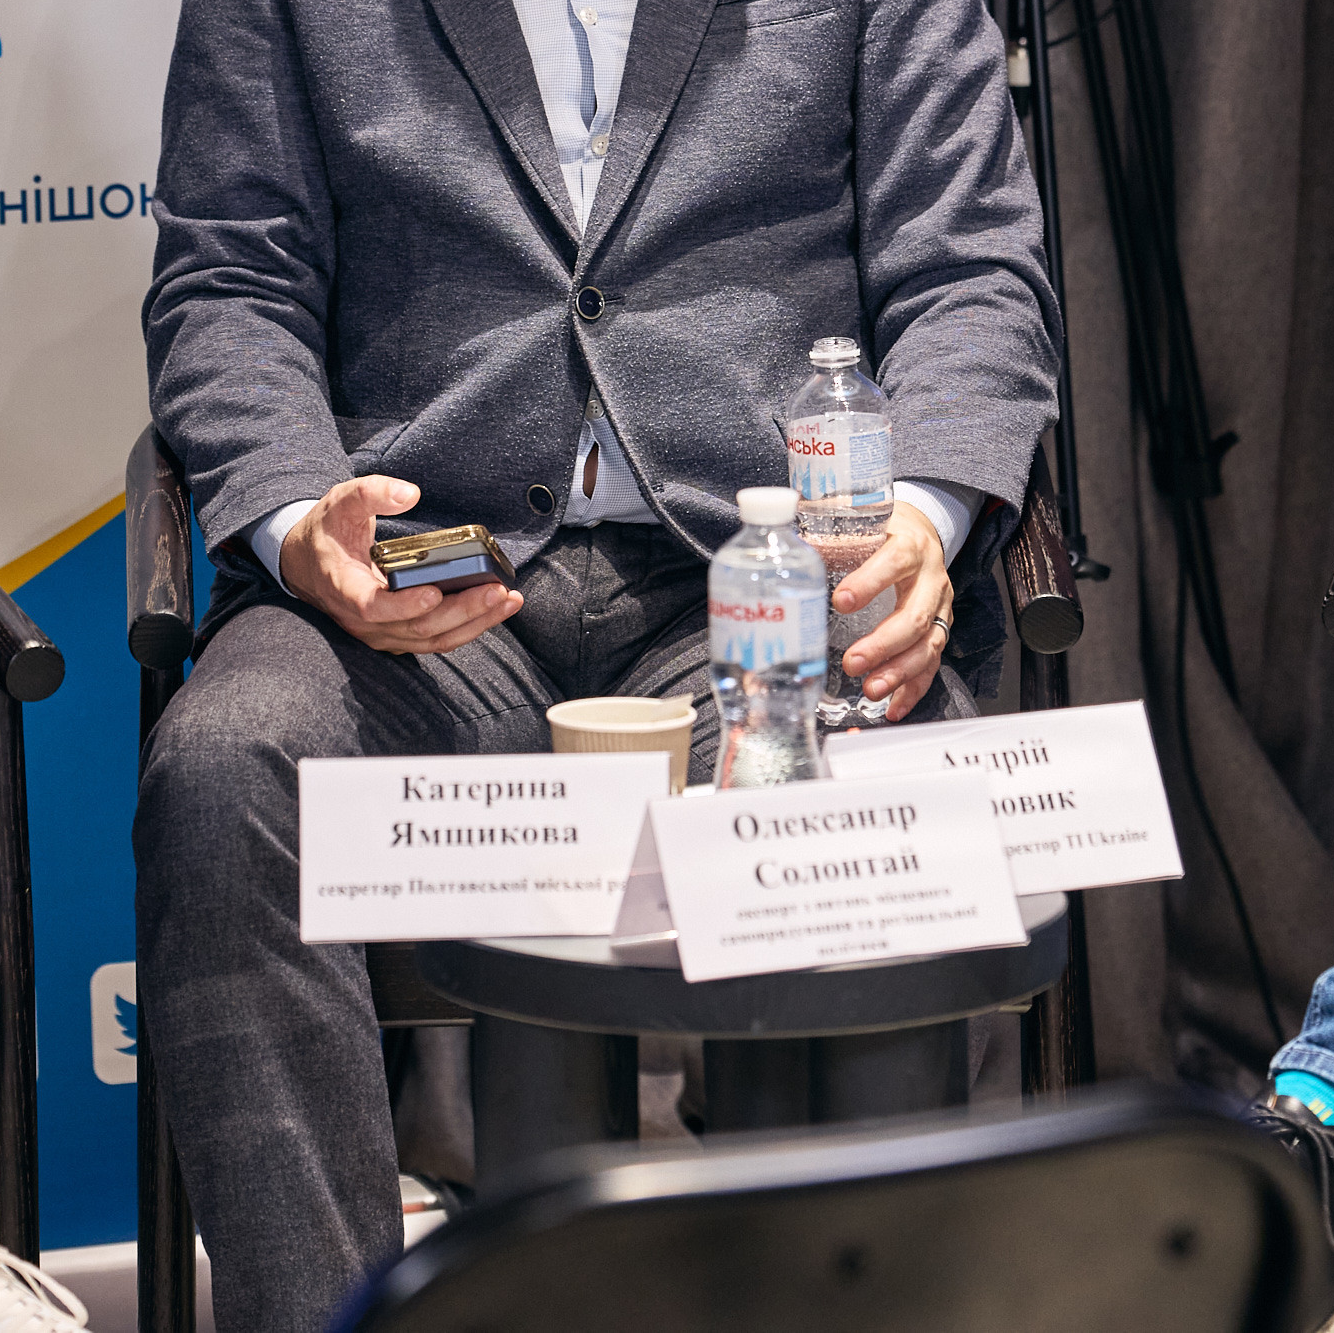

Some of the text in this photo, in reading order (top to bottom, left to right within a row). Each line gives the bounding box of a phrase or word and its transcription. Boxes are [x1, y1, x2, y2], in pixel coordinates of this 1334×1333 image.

[402, 775, 567, 807] Катерина
[390, 820, 579, 849] Ямщикова
[731, 803, 917, 844] Олександр
[1087, 828, 1148, 848] Ukraine
[754, 845, 921, 890] Солонтай
[317, 880, 403, 899] секретар
